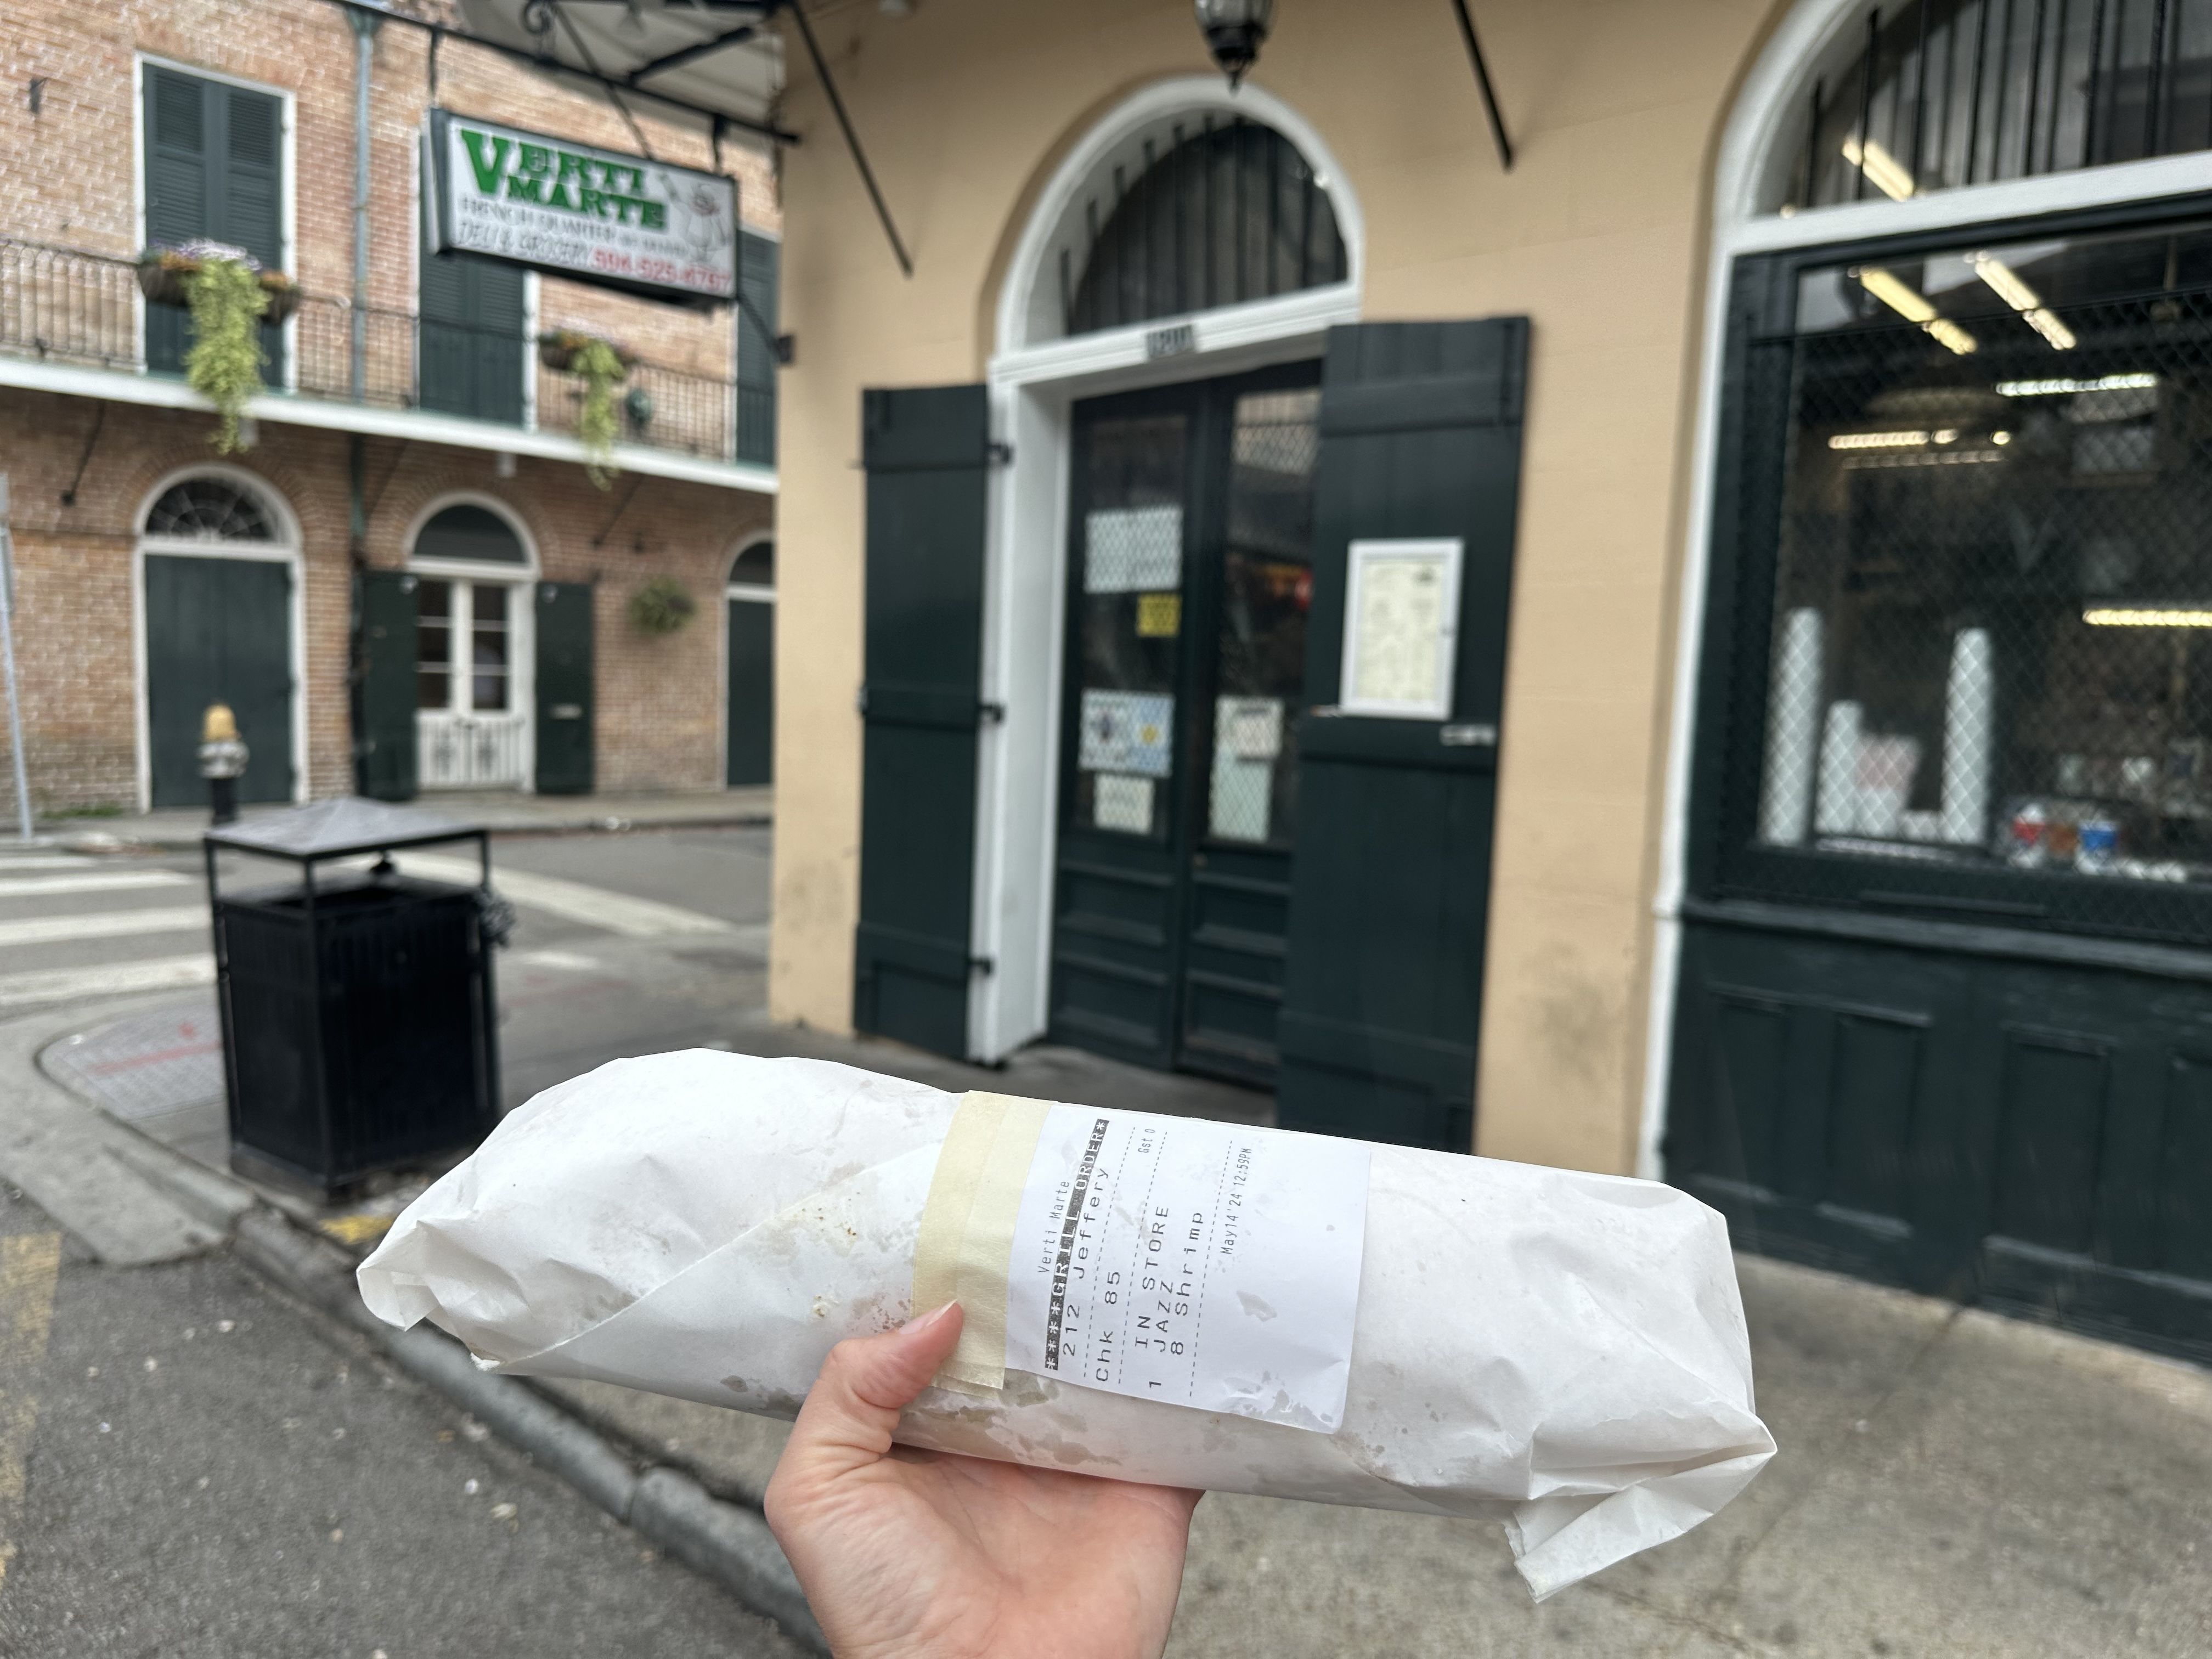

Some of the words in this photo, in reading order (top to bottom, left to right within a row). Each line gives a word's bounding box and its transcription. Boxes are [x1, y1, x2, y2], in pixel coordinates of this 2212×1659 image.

[461, 128, 643, 194] VERTI
[507, 175, 666, 229] MARTE
[1037, 1231, 1057, 1273] Verti
[1049, 1181, 1070, 1218] Marte
[1220, 1193, 1243, 1255] May14'24
[1233, 1148, 1252, 1186] 12:59PM
[1063, 1305, 1080, 1356] 212
[1073, 1169, 1109, 1279] Jeffery
[1096, 1331, 1113, 1381] Chk
[1105, 1272, 1120, 1305] 85
[1138, 1138, 1153, 1153] Gst
[1142, 1206, 1169, 1290] STORE
[1175, 1213, 1203, 1316] Shrimp
[1135, 1316, 1150, 1348] IN
[1154, 1280, 1173, 1352] JAZZ
[1171, 1341, 1183, 1355] 8
